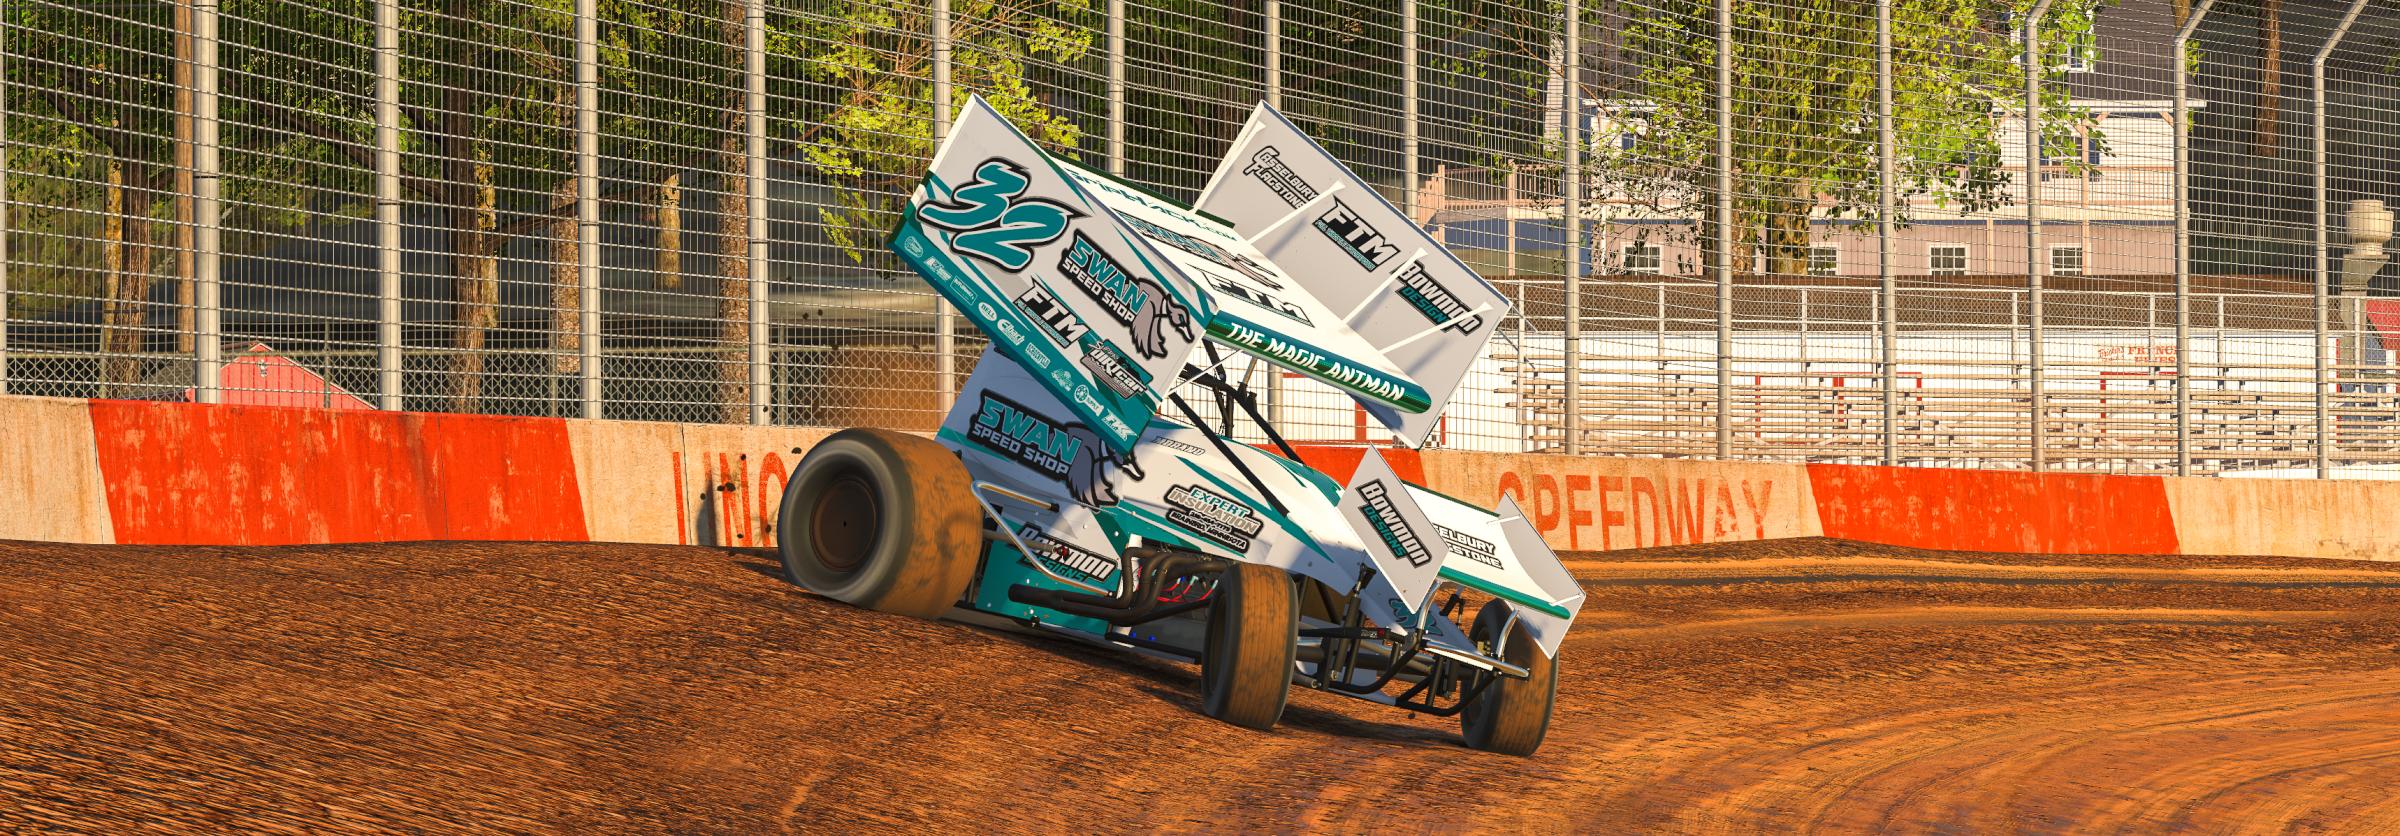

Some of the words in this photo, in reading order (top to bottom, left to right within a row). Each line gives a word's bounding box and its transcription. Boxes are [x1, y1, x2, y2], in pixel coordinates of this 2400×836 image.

[1252, 145, 1319, 201] CASSELBURY
[916, 157, 1080, 272] 32
[1320, 201, 1400, 267] FTM
[1061, 258, 1103, 295] SPEED
[1101, 289, 1135, 323] SHOP
[1069, 235, 1150, 314] SWAN
[1203, 269, 1310, 321] FTM
[1020, 282, 1091, 344] FTM
[1401, 286, 1448, 324] DESIGN
[1226, 322, 1265, 348] THE
[1266, 338, 1325, 371] MAGIC
[1325, 361, 1405, 401] ANTMAN
[972, 423, 1020, 454] SPEED
[1023, 449, 1069, 476] SHOP
[979, 398, 1082, 465] SWAN
[1168, 490, 1259, 534] INSULATION
[1191, 489, 1250, 518] EXPERT
[1363, 505, 1407, 557] DESIGNS
